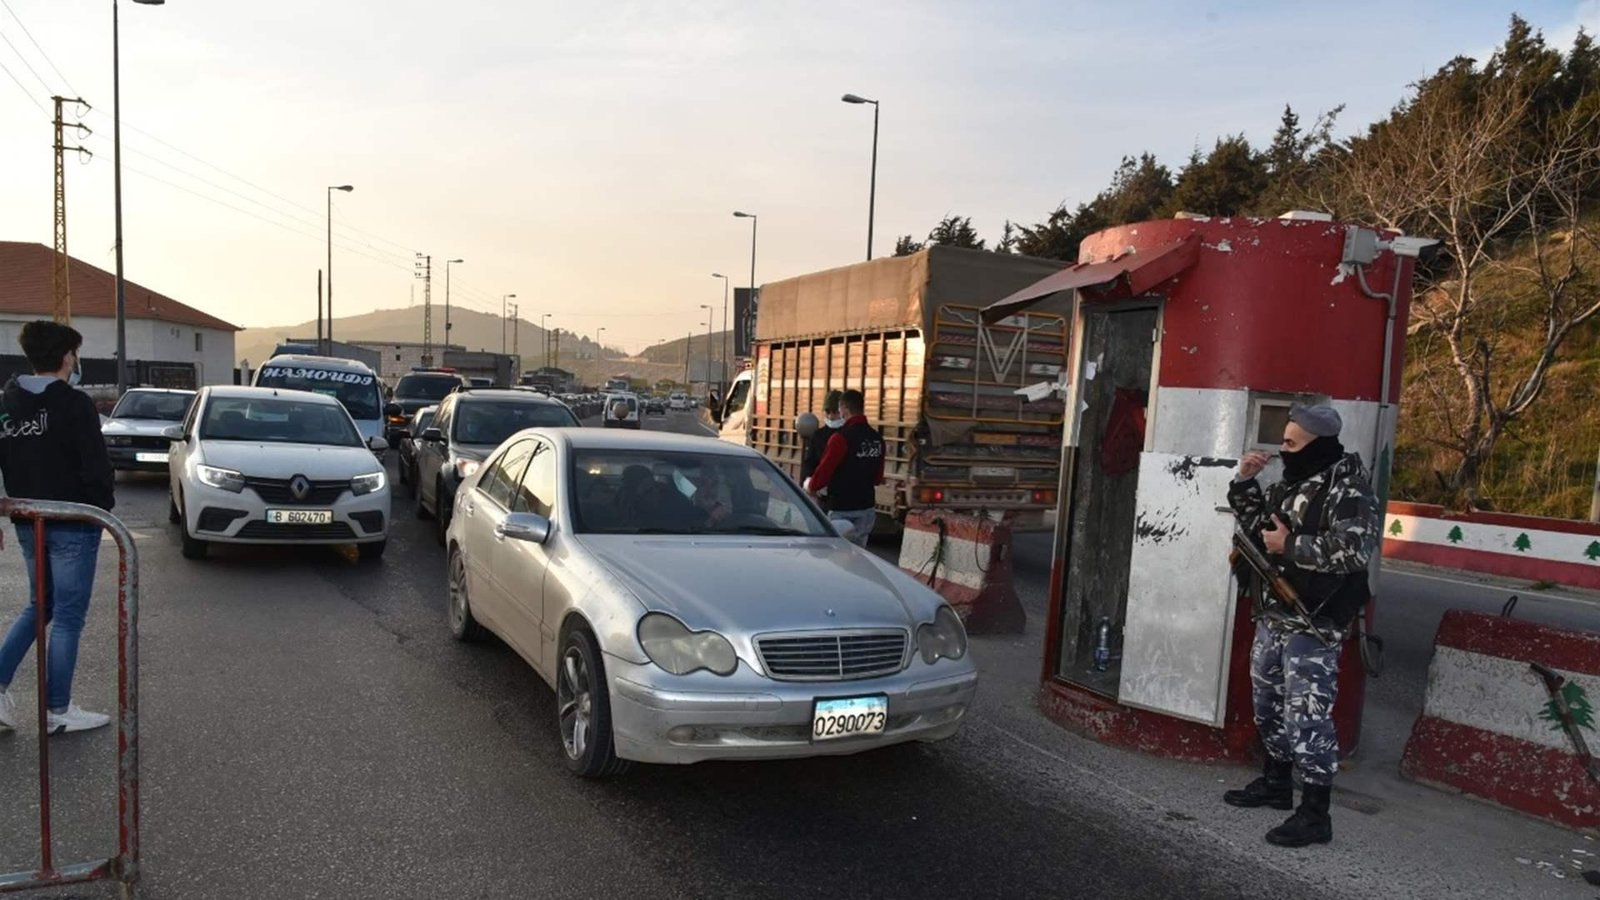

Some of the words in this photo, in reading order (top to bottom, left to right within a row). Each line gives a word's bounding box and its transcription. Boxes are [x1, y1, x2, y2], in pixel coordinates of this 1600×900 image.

[275, 511, 282, 521] B
[288, 511, 326, 523] 602470
[815, 711, 885, 736] 0290073
